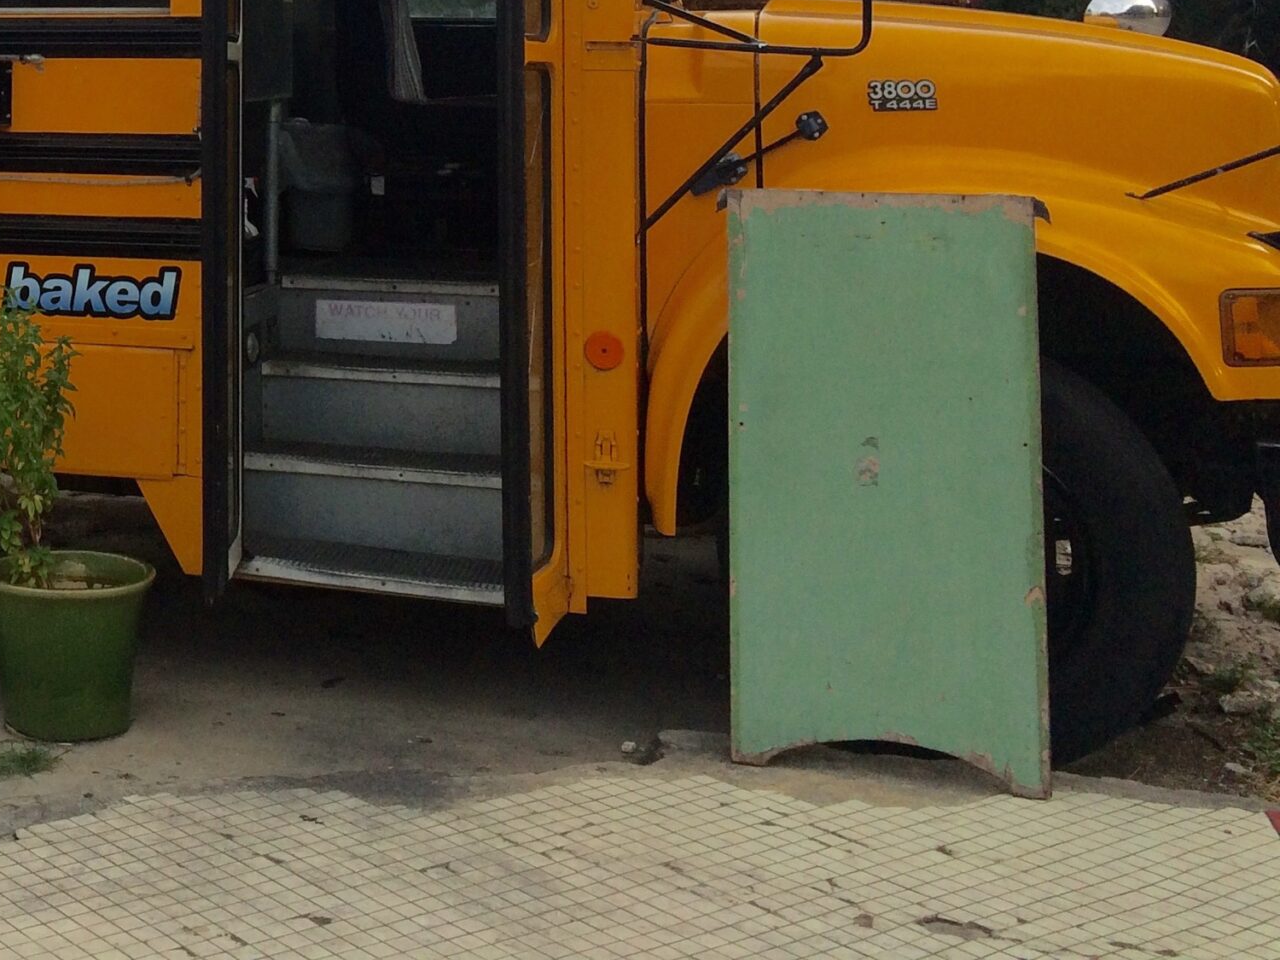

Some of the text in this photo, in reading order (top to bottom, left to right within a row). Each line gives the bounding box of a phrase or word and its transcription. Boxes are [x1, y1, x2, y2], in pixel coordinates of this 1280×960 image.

[869, 81, 935, 99] 3800
[871, 100, 937, 110] T 444E
[7, 266, 177, 315] baked
